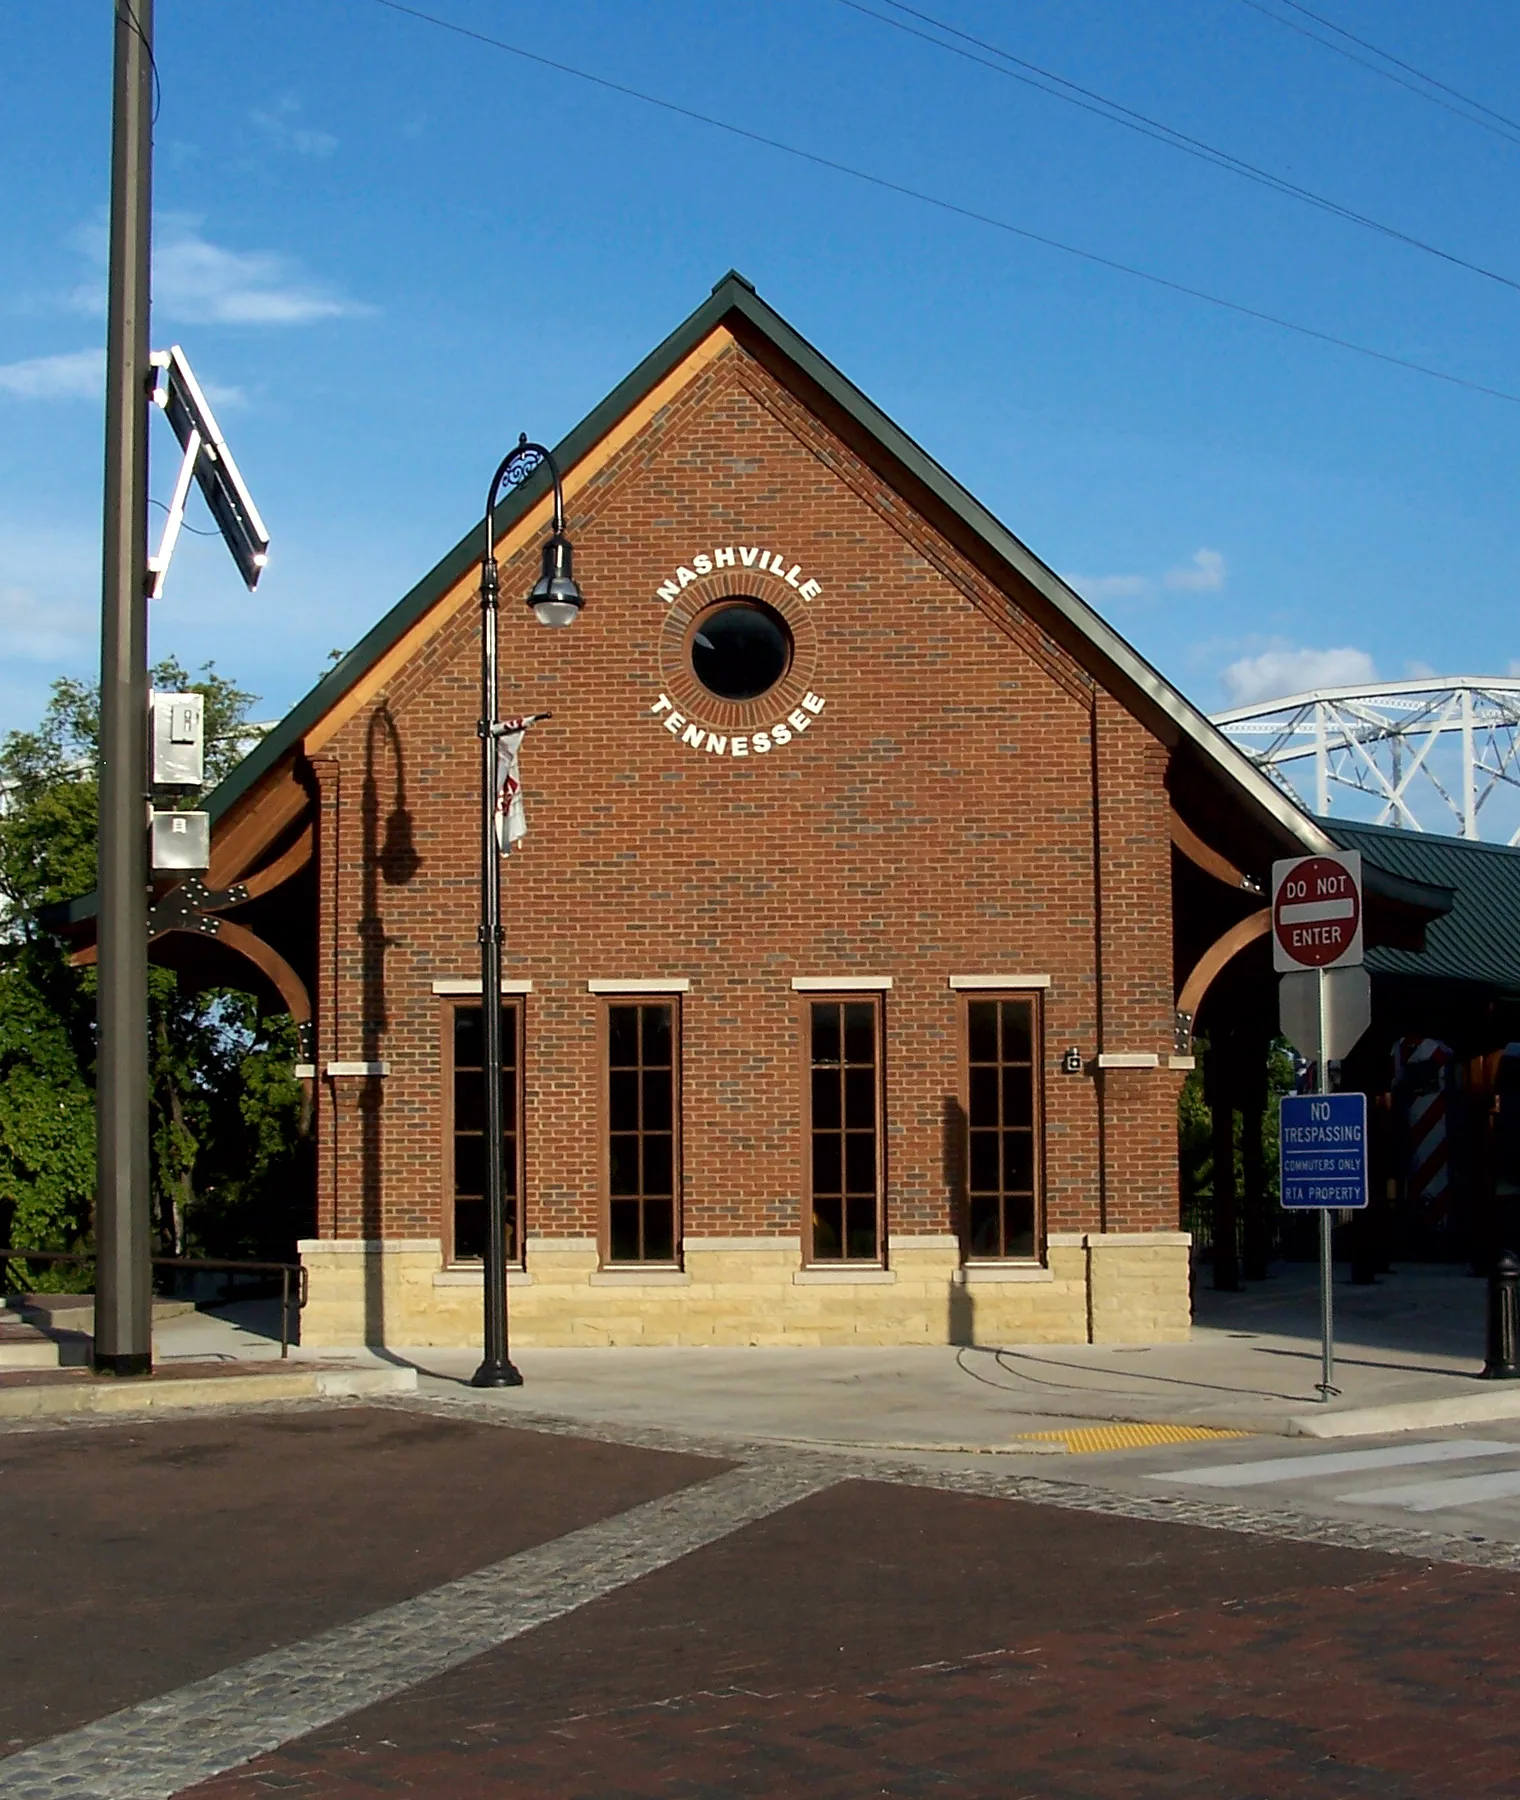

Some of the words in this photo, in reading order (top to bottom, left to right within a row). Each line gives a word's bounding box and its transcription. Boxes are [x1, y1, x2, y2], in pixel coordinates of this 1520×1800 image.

[656, 546, 823, 603] NASHVILLE
[651, 691, 826, 757] TENNESSEE
[1287, 880, 1307, 899] DO
[1317, 875, 1347, 896] NOT
[1292, 926, 1342, 947] ENTER
[1311, 1101, 1331, 1121] NO
[1284, 1125, 1361, 1143] TRESPASSING
[1284, 1159, 1335, 1172] COMMUTERS
[1338, 1159, 1361, 1171] ONLY
[1285, 1187, 1304, 1200] RTA
[1308, 1187, 1361, 1200] PROPERTY
